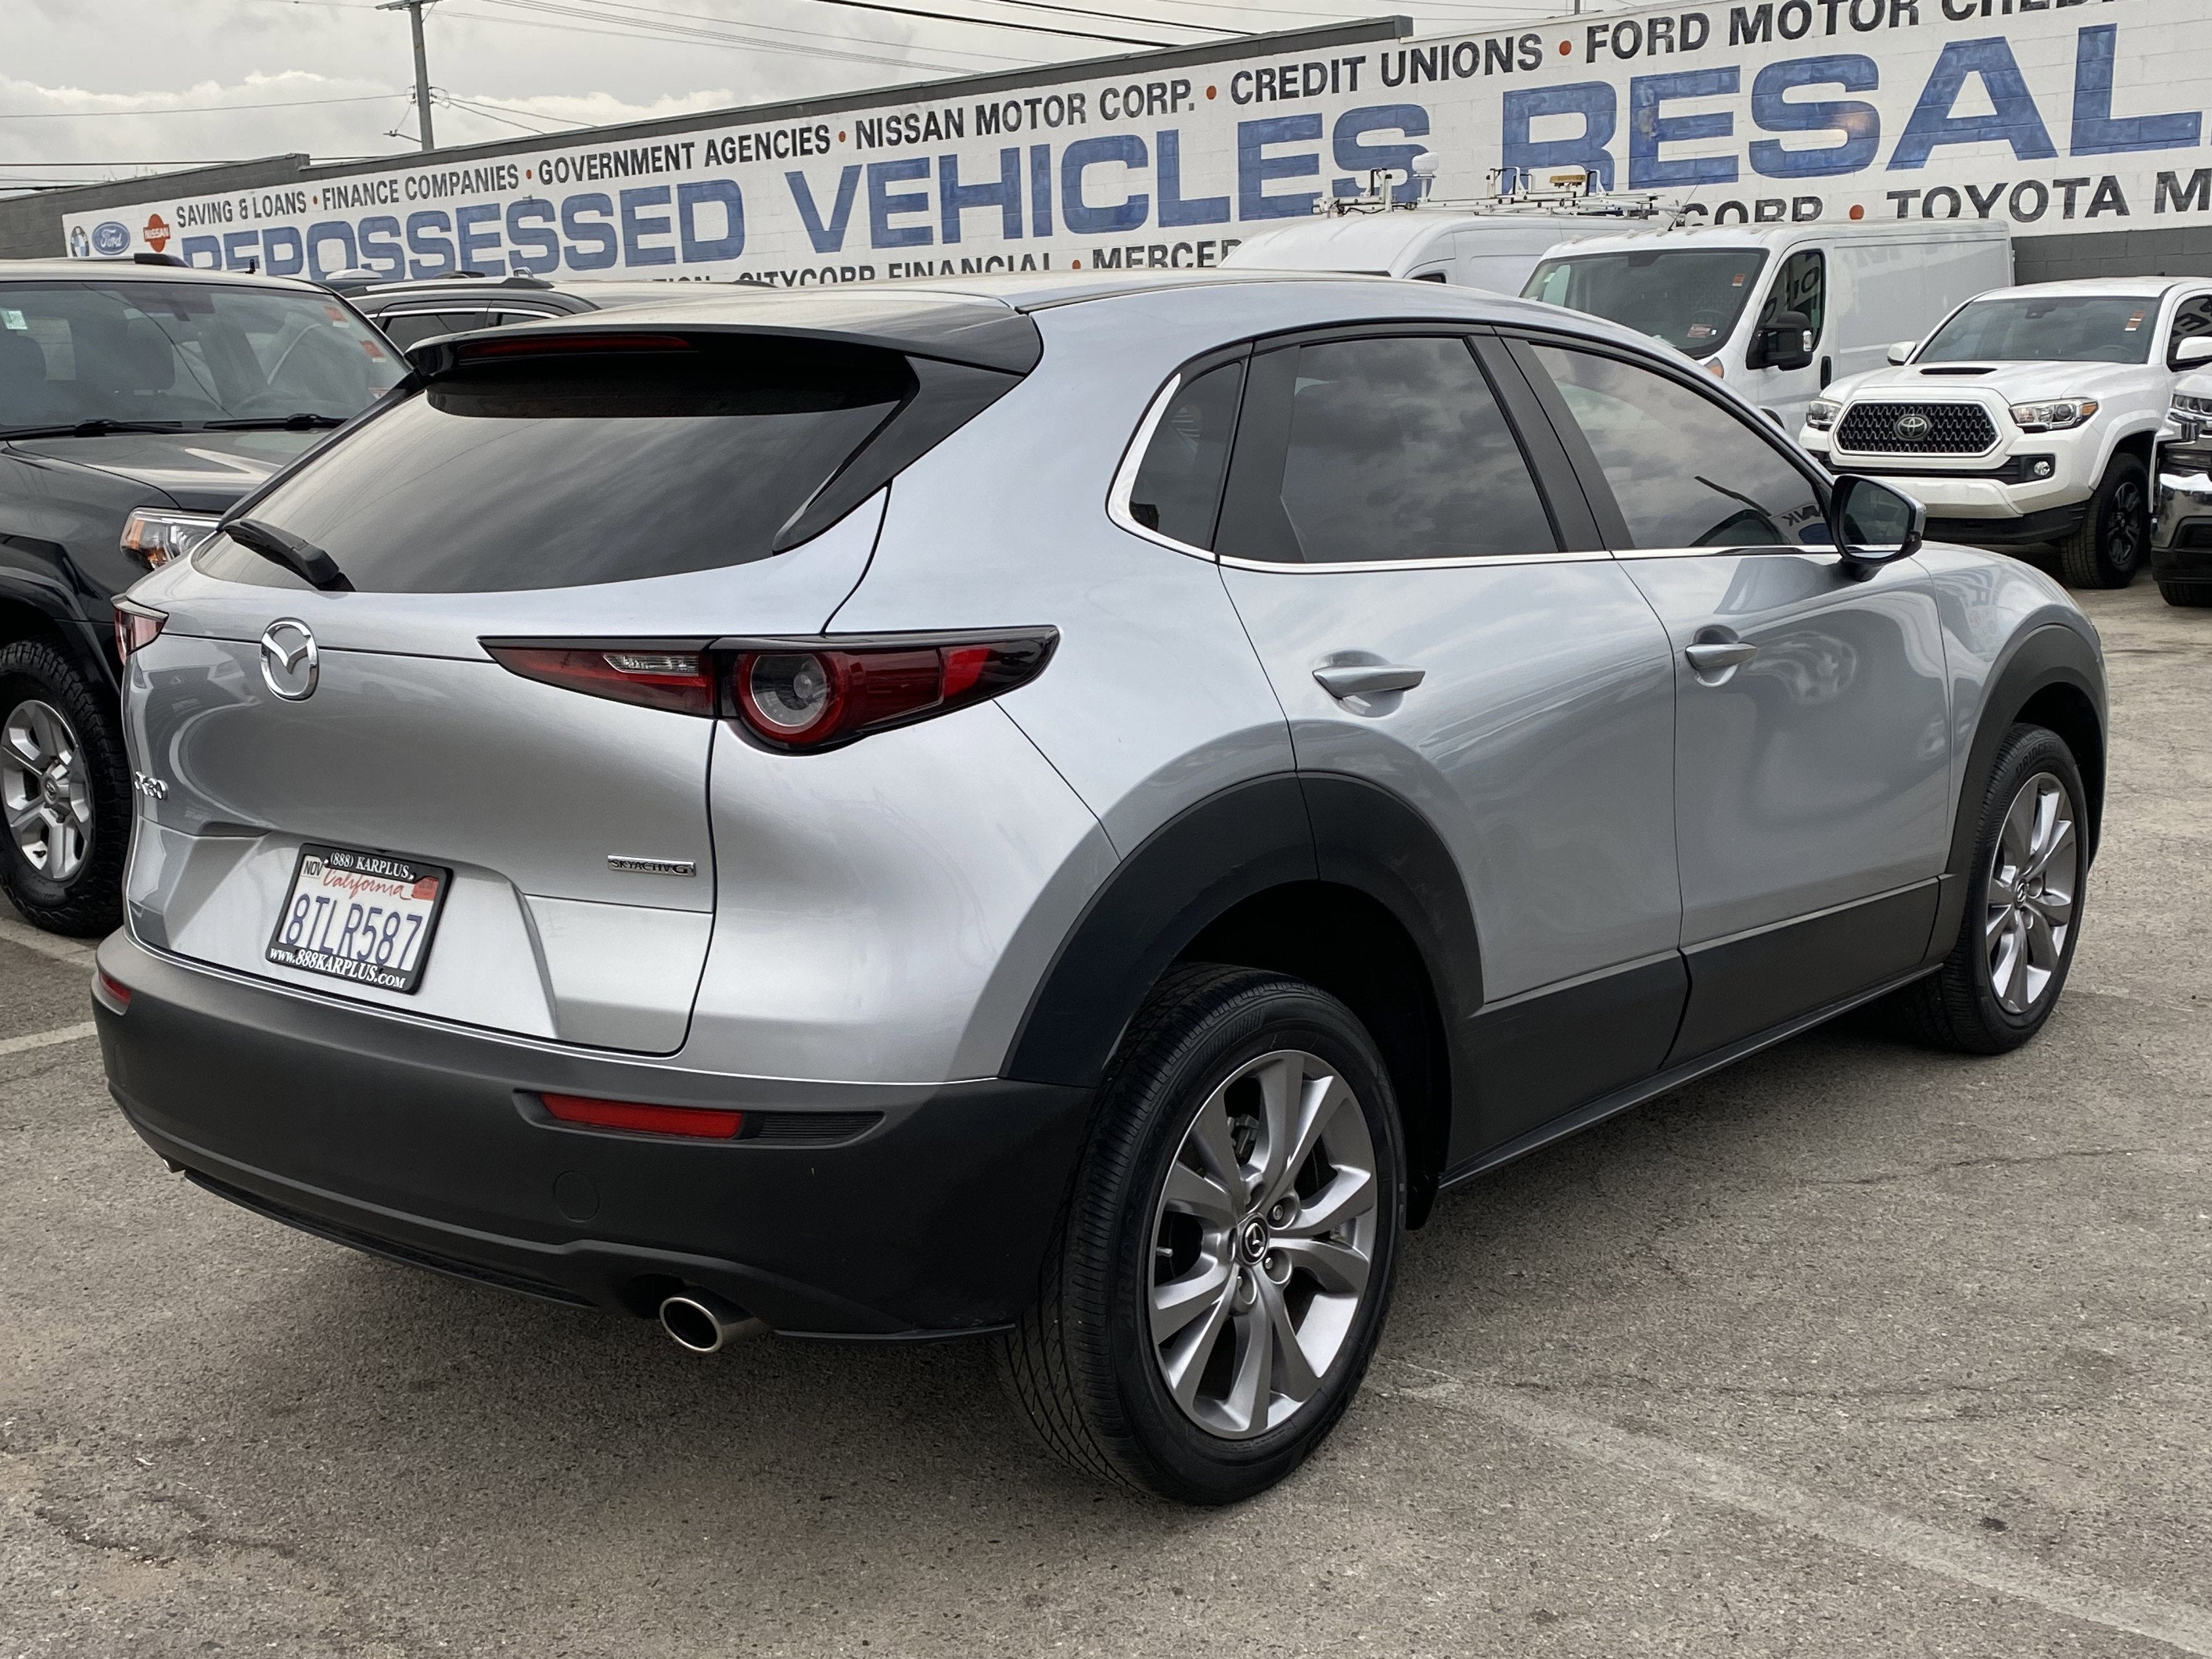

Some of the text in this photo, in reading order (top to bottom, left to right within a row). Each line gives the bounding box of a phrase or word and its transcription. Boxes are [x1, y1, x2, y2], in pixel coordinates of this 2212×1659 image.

[176, 200, 233, 228] SAVING
[239, 198, 249, 219] &
[253, 191, 307, 218] LOANS
[322, 179, 399, 210] FINANCE
[405, 164, 519, 201] COMPANIES
[538, 141, 695, 185] GOVERNMENT
[704, 125, 831, 167] AGENCIES
[855, 106, 964, 150] NISSAN
[975, 92, 1086, 136] MOTOR
[1099, 78, 1195, 121] CORP.
[1231, 55, 1366, 105] CREDIT
[1381, 33, 1543, 87] UNIONS
[1586, 12, 1710, 64] FORD
[1729, 0, 1920, 47] MOTOR
[182, 23, 2212, 281] REPOSSESSED VEHICLES RESAL
[1885, 174, 2131, 223] TOYOTA
[100, 228, 123, 248] Ford
[144, 226, 169, 241] NISSAN
[304, 860, 323, 876] NOV
[330, 851, 410, 879] (888) KARPLUS
[323, 869, 412, 901] California
[285, 893, 424, 970] 8TLR587
